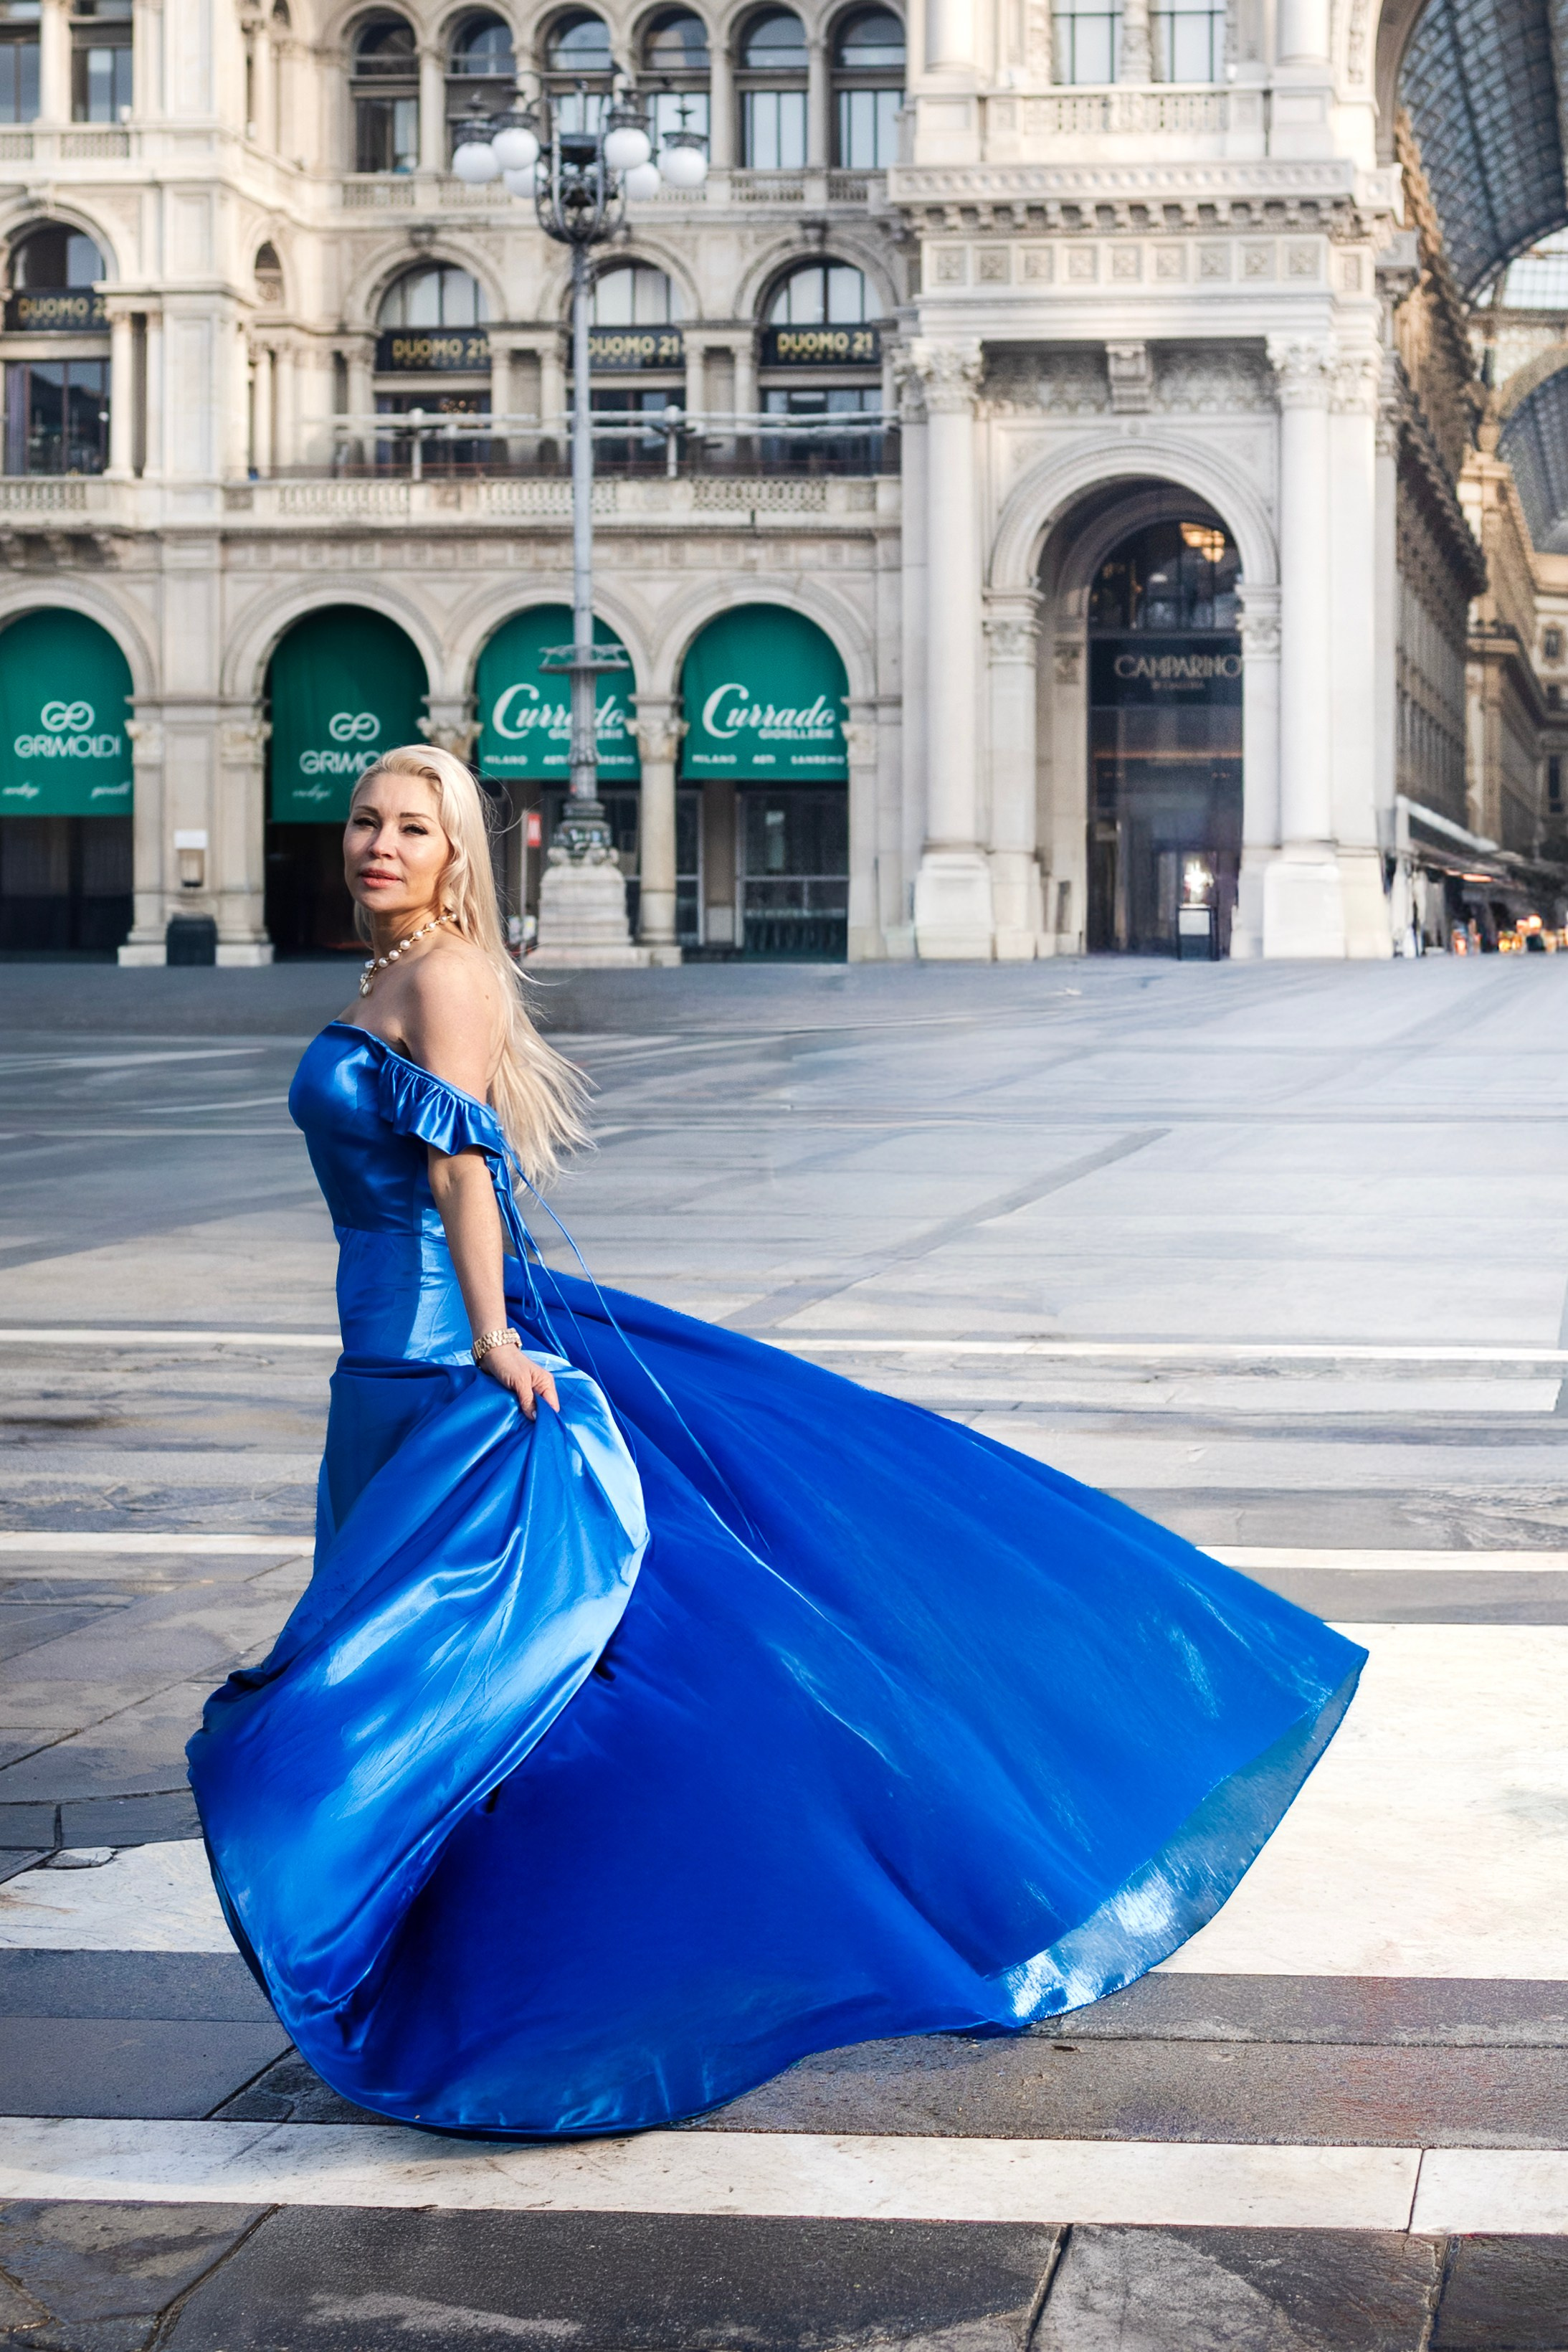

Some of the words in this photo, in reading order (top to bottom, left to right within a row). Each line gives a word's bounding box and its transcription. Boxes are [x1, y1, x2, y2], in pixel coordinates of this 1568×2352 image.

[18, 297, 89, 318] DUOMO
[92, 297, 104, 317] 2
[392, 338, 463, 359] DUOMO
[467, 338, 488, 358] 21
[659, 336, 679, 356] 21
[777, 332, 849, 353] DUOMO
[853, 332, 873, 352] 21
[1115, 654, 1242, 678] CAMPARINO
[702, 683, 835, 739] Currado
[548, 728, 624, 740] GIOERIE
[758, 728, 835, 740] GIOIELLERIE
[14, 734, 122, 759] GRIMOLDI
[299, 750, 382, 774] GRIMO
[483, 755, 528, 765] MILANO
[692, 754, 737, 764] MILANO
[752, 754, 776, 764] ASTI
[791, 755, 845, 765] SANREMO
